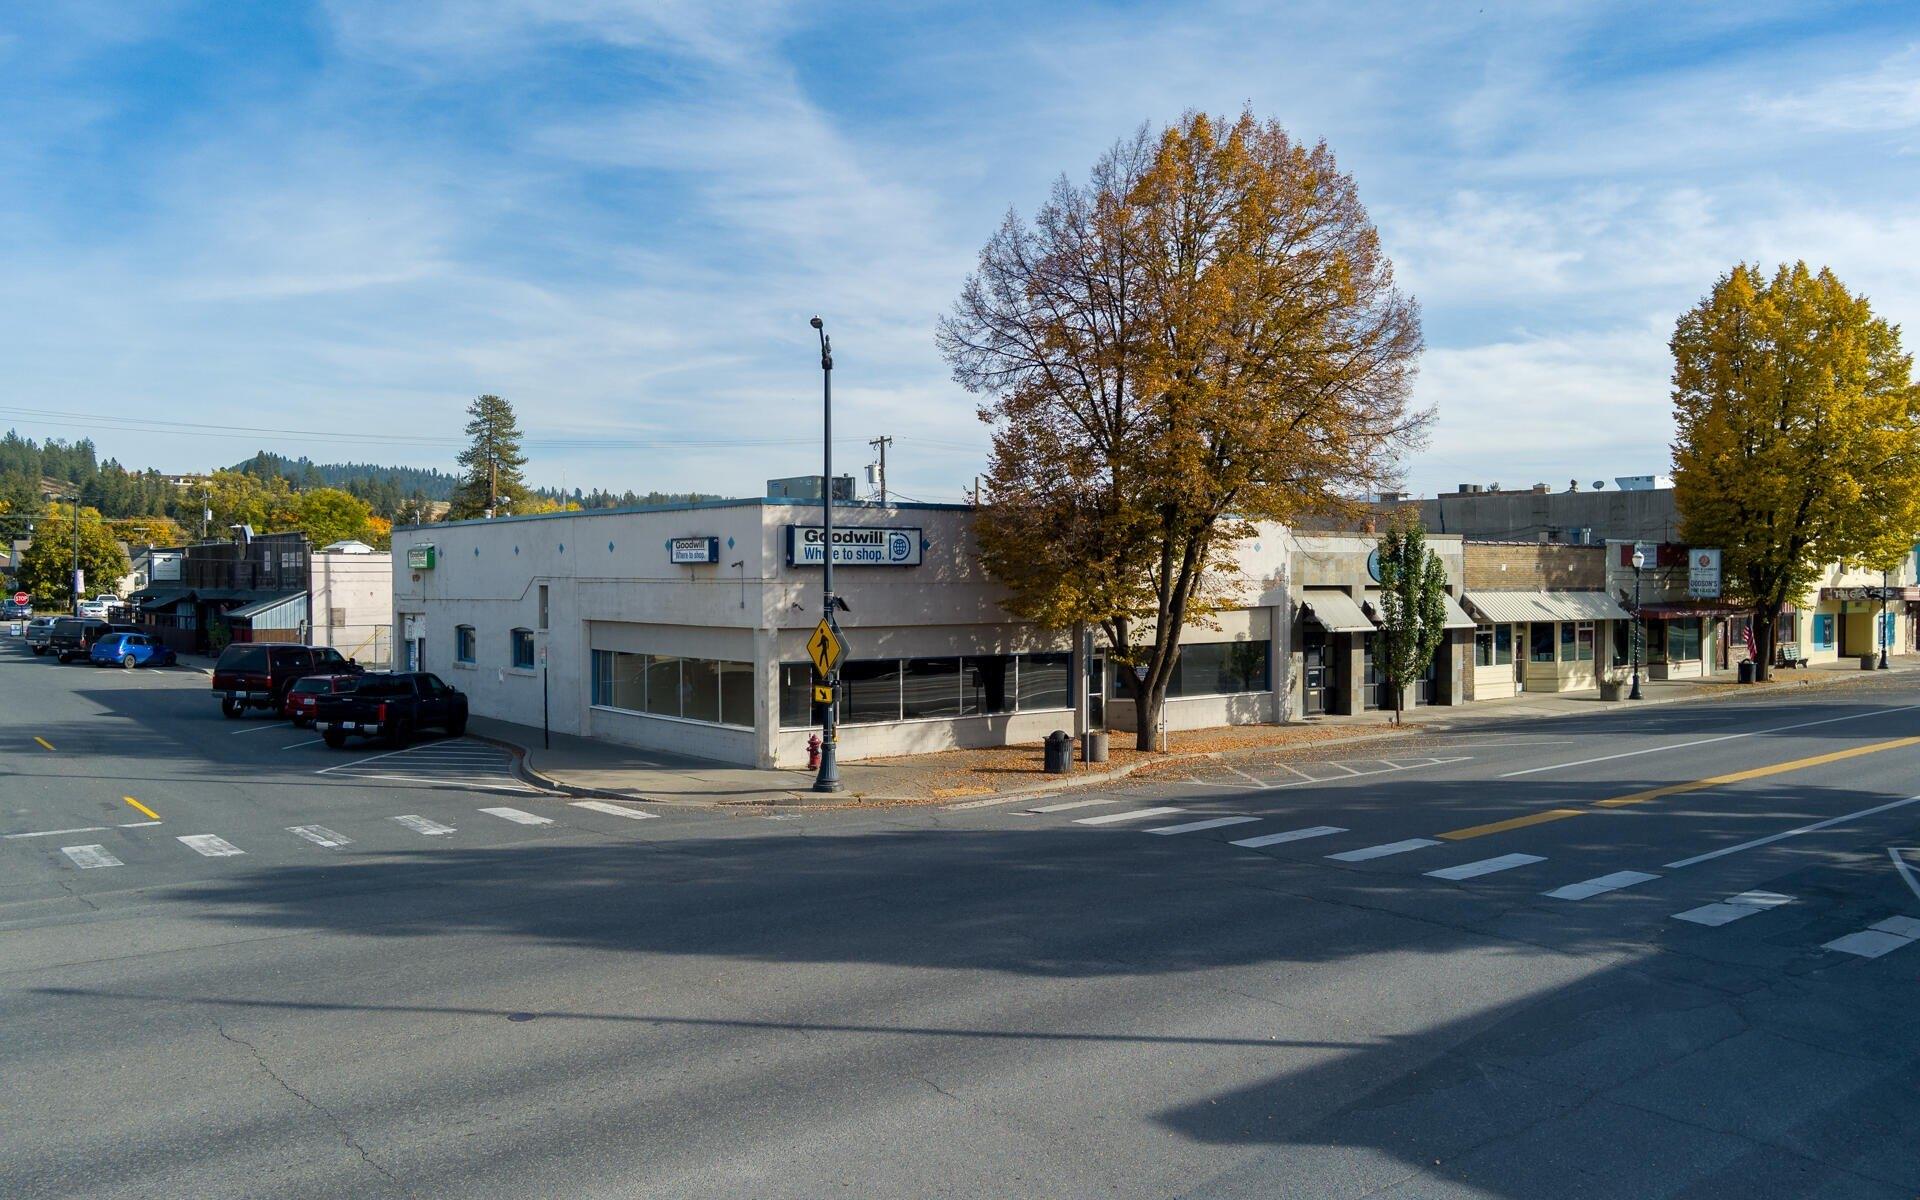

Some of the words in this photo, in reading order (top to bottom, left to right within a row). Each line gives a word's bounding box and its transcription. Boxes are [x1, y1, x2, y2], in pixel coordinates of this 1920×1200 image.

[675, 541, 705, 549] Goodwill
[804, 547, 839, 560] Whe
[842, 548, 853, 560] to
[856, 548, 885, 563] shop.
